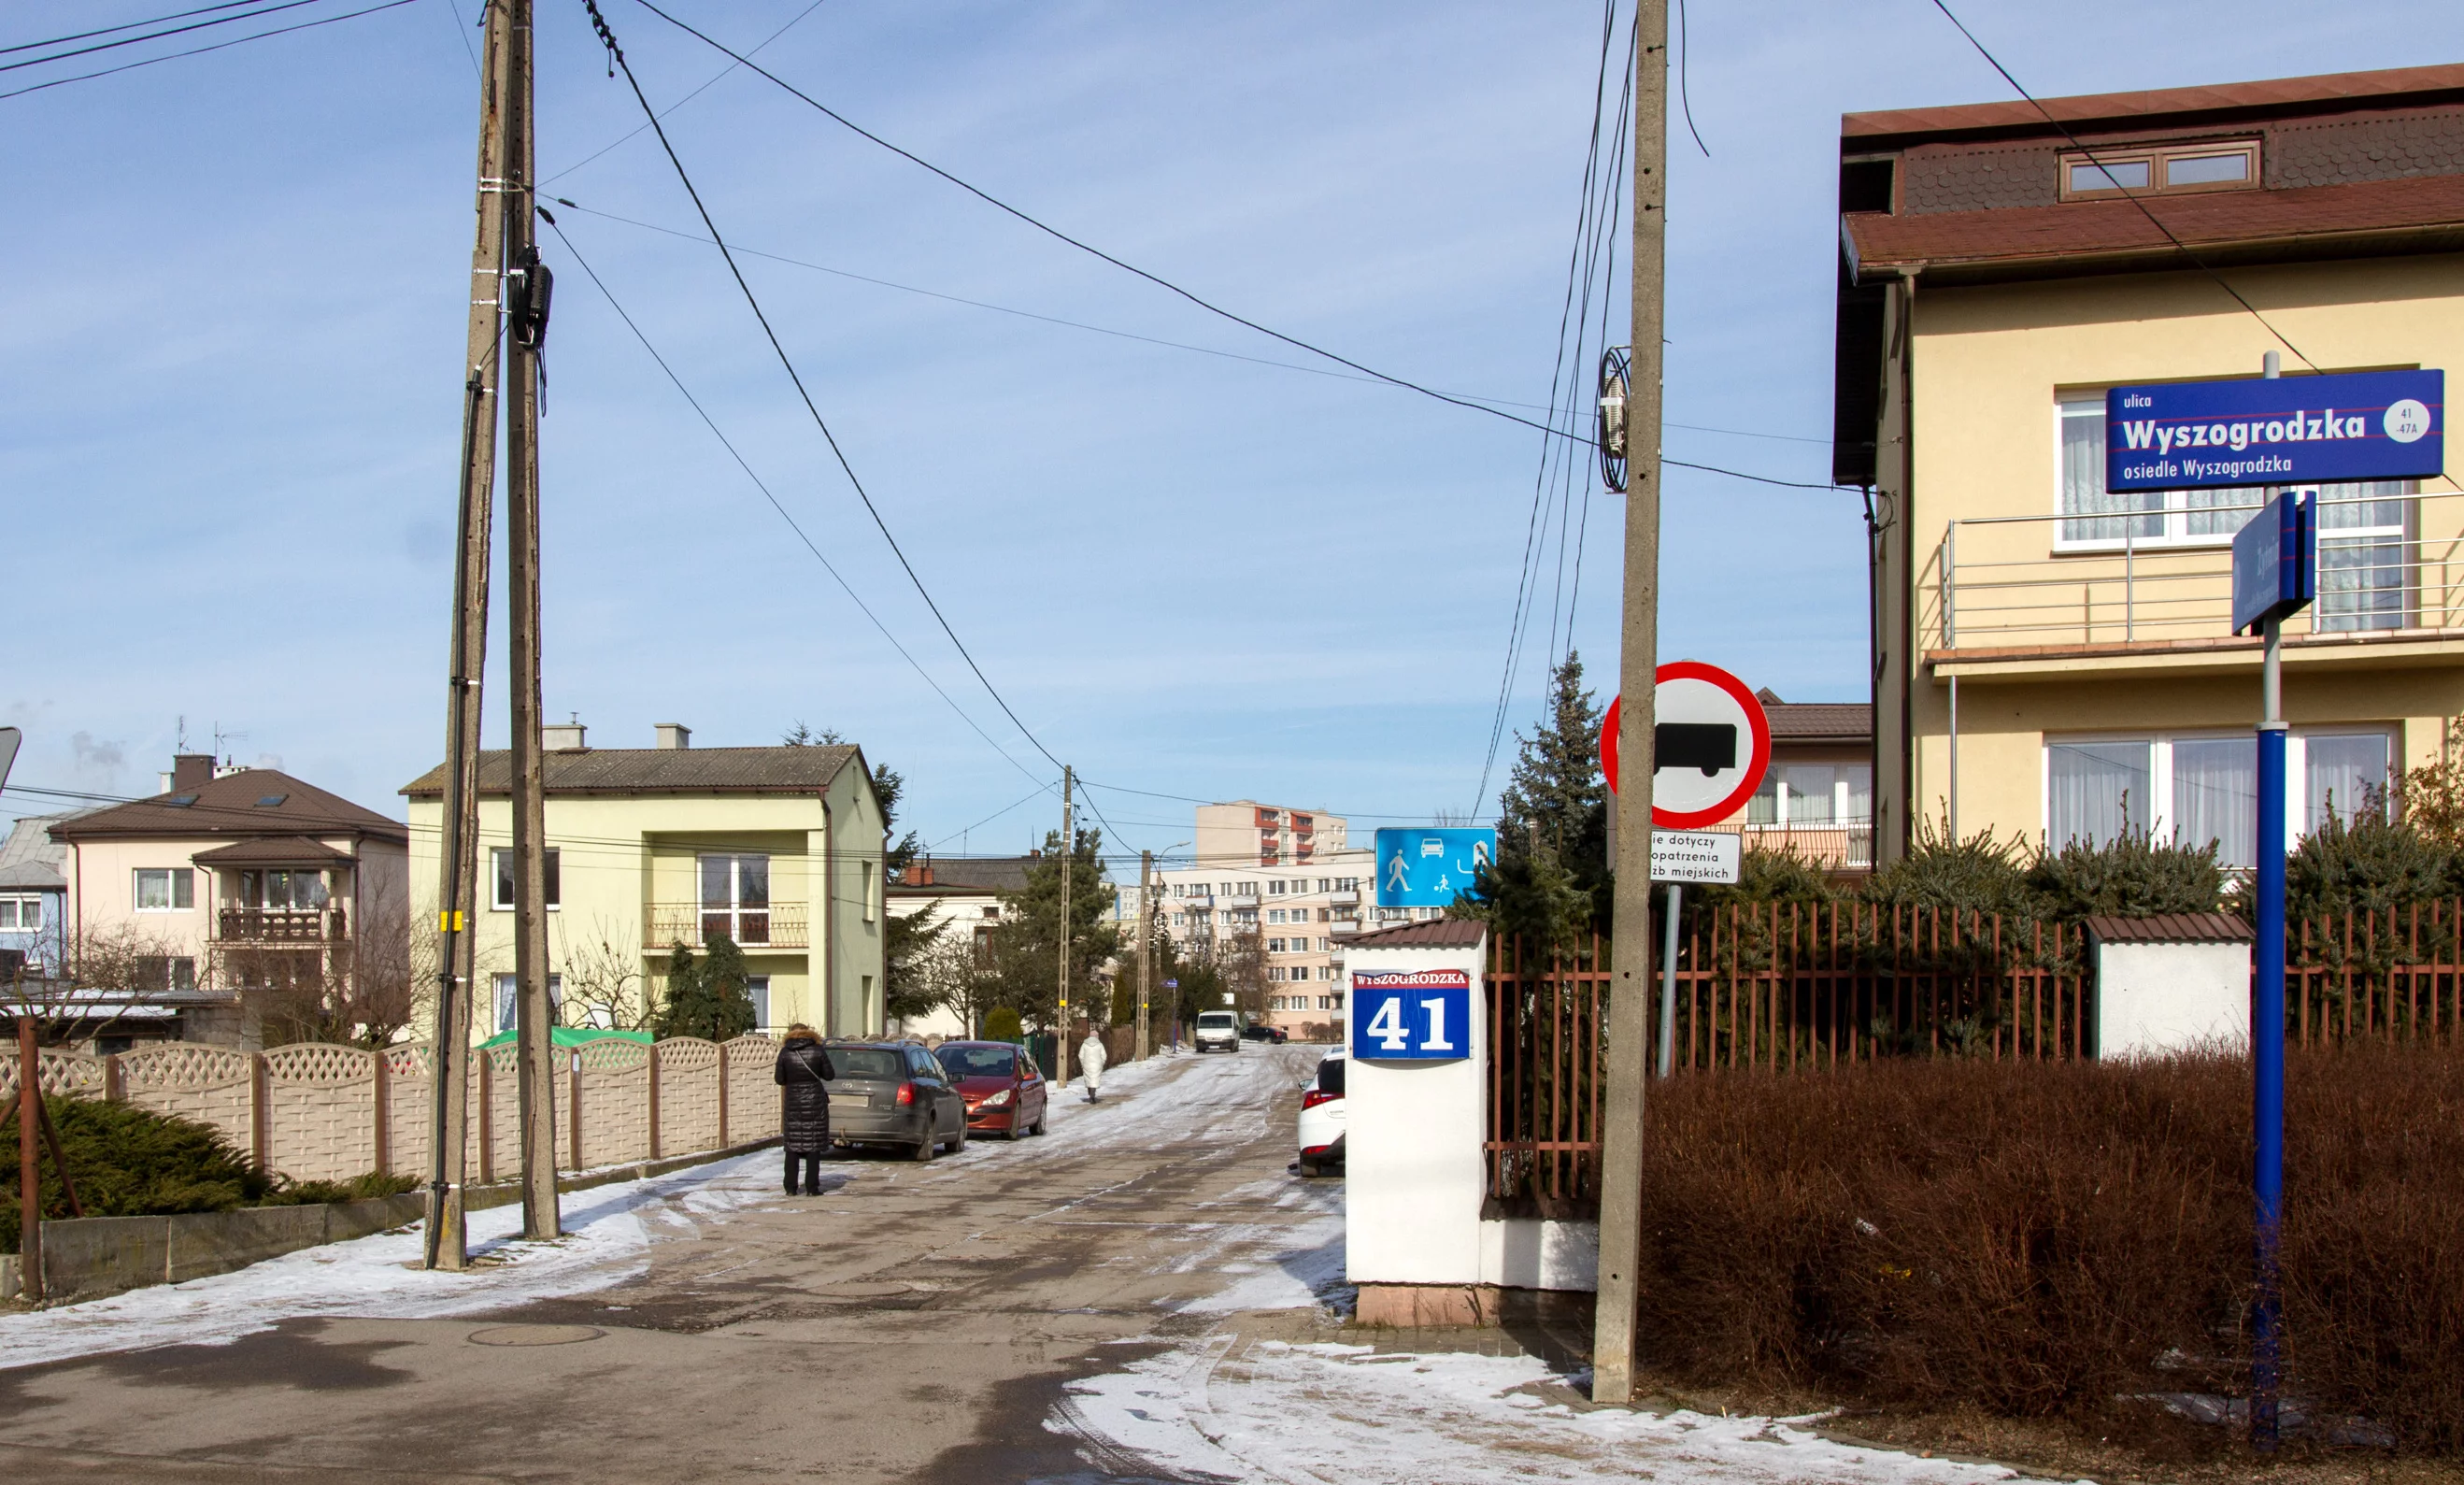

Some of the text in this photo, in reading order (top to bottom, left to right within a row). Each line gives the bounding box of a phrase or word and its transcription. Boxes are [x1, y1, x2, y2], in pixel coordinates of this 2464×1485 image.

[2124, 393, 2152, 408] ulica
[2400, 407, 2412, 419] 41
[2122, 408, 2365, 455] Wyszogrodzka
[2396, 423, 2418, 435] -47A
[2124, 455, 2292, 480] osiedle Wyszogrodzka
[1652, 834, 1716, 850] ie dotyczy
[1651, 850, 1718, 863] opatrzenia
[1652, 864, 1729, 879] żb miejskich
[1356, 973, 1466, 985] WYSZOGRODZKA
[1366, 996, 1454, 1050] 41
